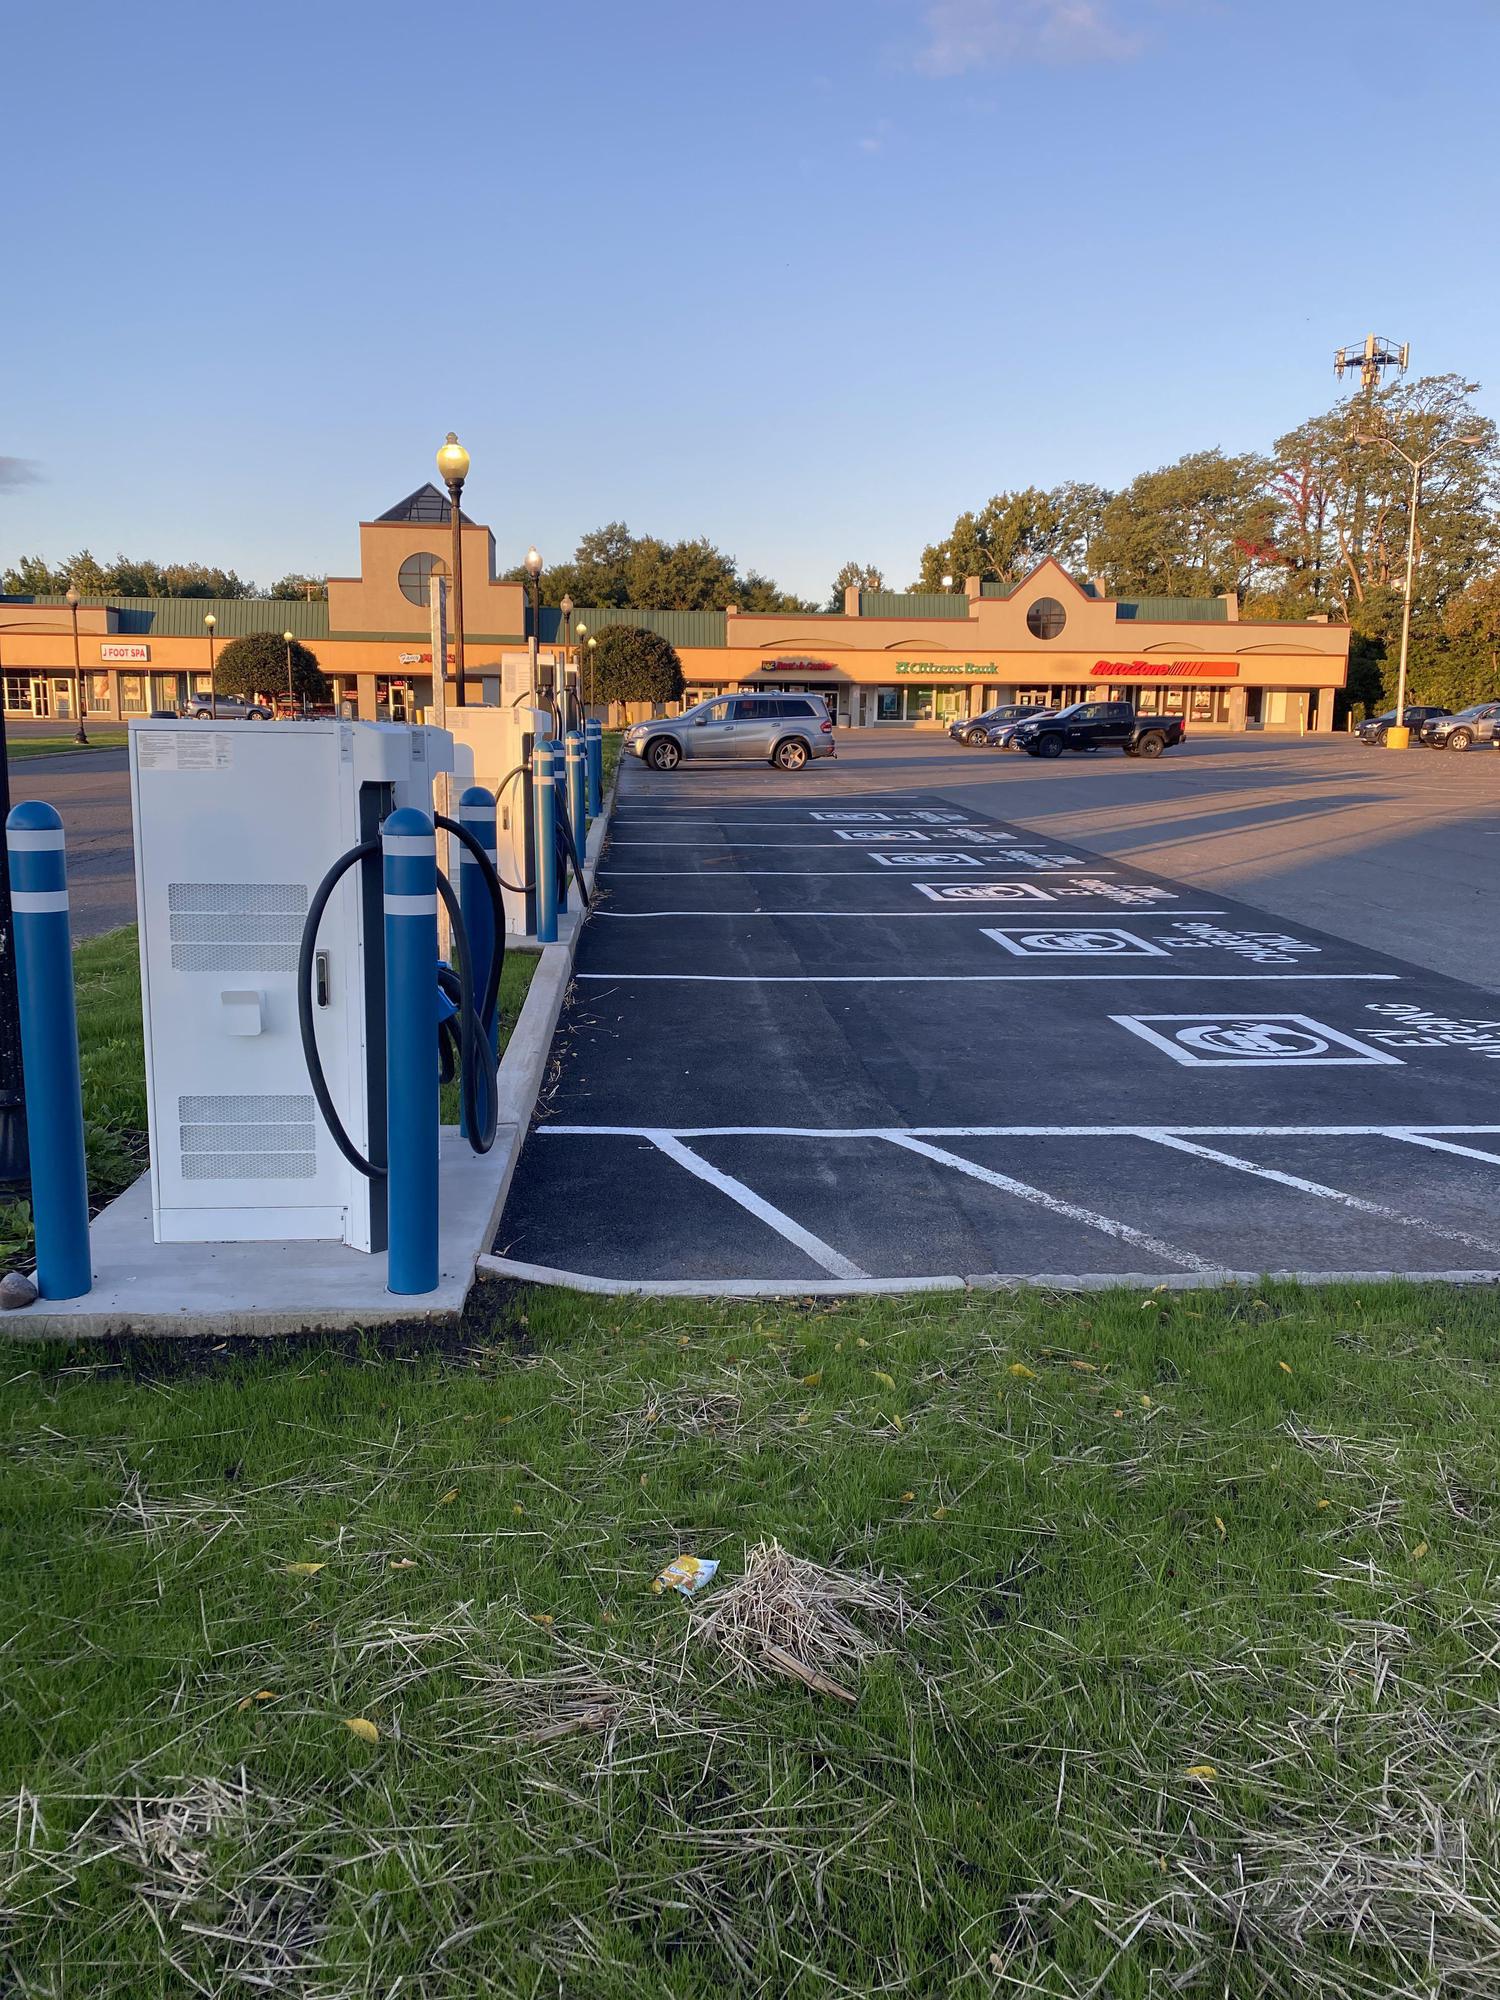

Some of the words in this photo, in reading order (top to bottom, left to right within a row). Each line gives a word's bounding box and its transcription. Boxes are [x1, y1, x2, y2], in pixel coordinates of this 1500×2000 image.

[108, 648, 129, 657] FOOT
[131, 648, 146, 657] SPA
[910, 662, 964, 675] Citizens
[965, 662, 999, 675] Bank
[1089, 660, 1170, 675] AutoZone
[1152, 936, 1214, 949] EV
[1171, 922, 1299, 963] CHARGING
[1235, 931, 1323, 953] ONLY
[1353, 1028, 1450, 1047] EV
